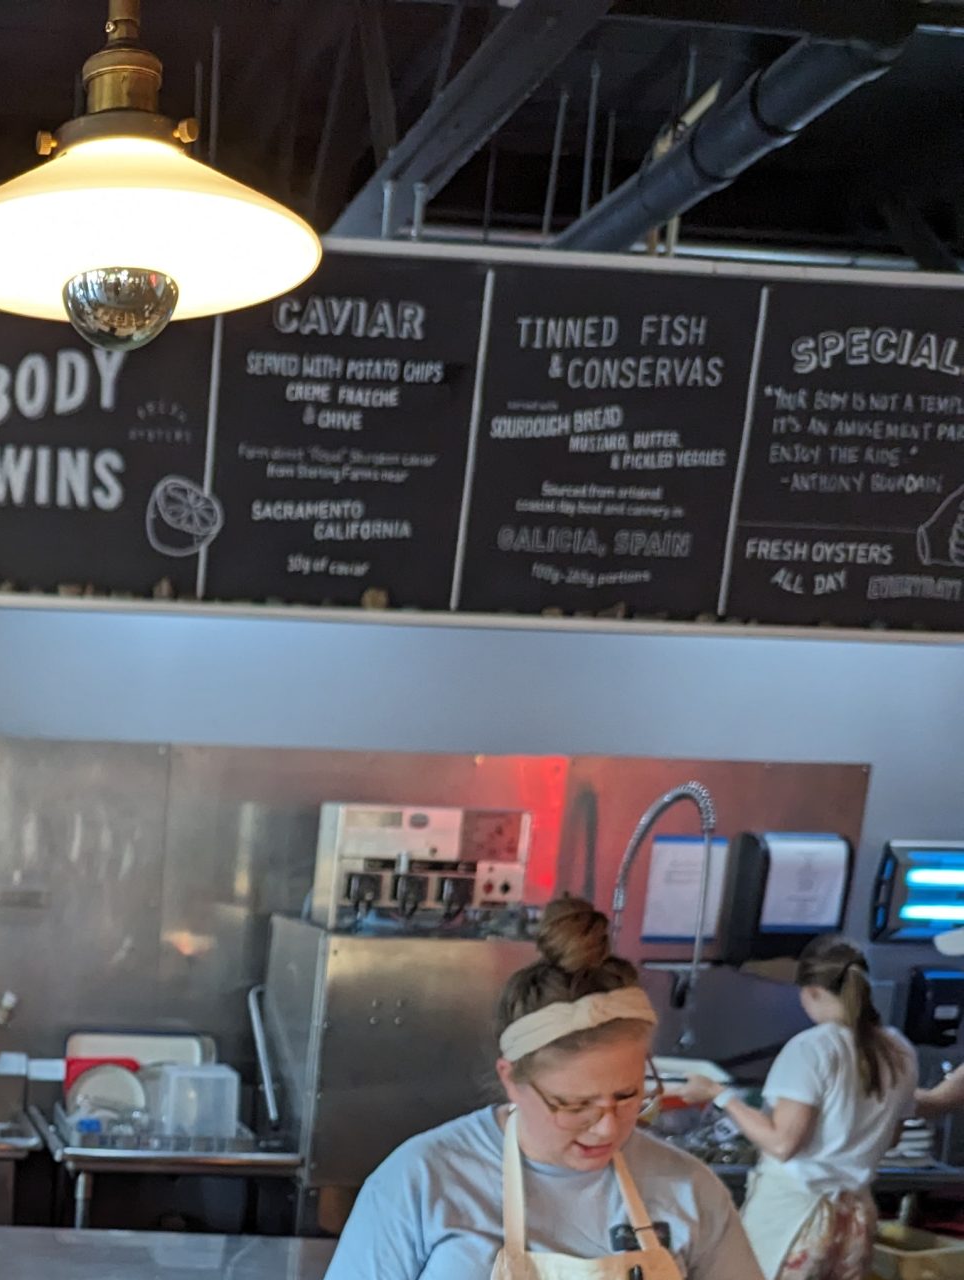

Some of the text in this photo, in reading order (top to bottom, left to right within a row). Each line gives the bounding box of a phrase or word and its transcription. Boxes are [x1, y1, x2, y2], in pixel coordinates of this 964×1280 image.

[273, 296, 425, 340] CAVIAR
[516, 314, 707, 348] TINNED FISH
[346, 358, 401, 382] POTATO
[403, 359, 445, 383] CHIPS
[567, 355, 724, 389] CONSERVAS
[869, 393, 900, 411] NOT
[903, 393, 915, 412] A
[490, 414, 571, 439] SOURDOUGH
[573, 404, 623, 433] BREAD
[829, 445, 860, 464] THE
[251, 499, 365, 521] SACRAMENTO
[313, 520, 412, 541] CALIFORNIA
[612, 528, 693, 557] SPAIN
[745, 537, 893, 566] FRESH OYSTERS
[770, 567, 803, 595] ALL
[813, 568, 847, 595] DAY
